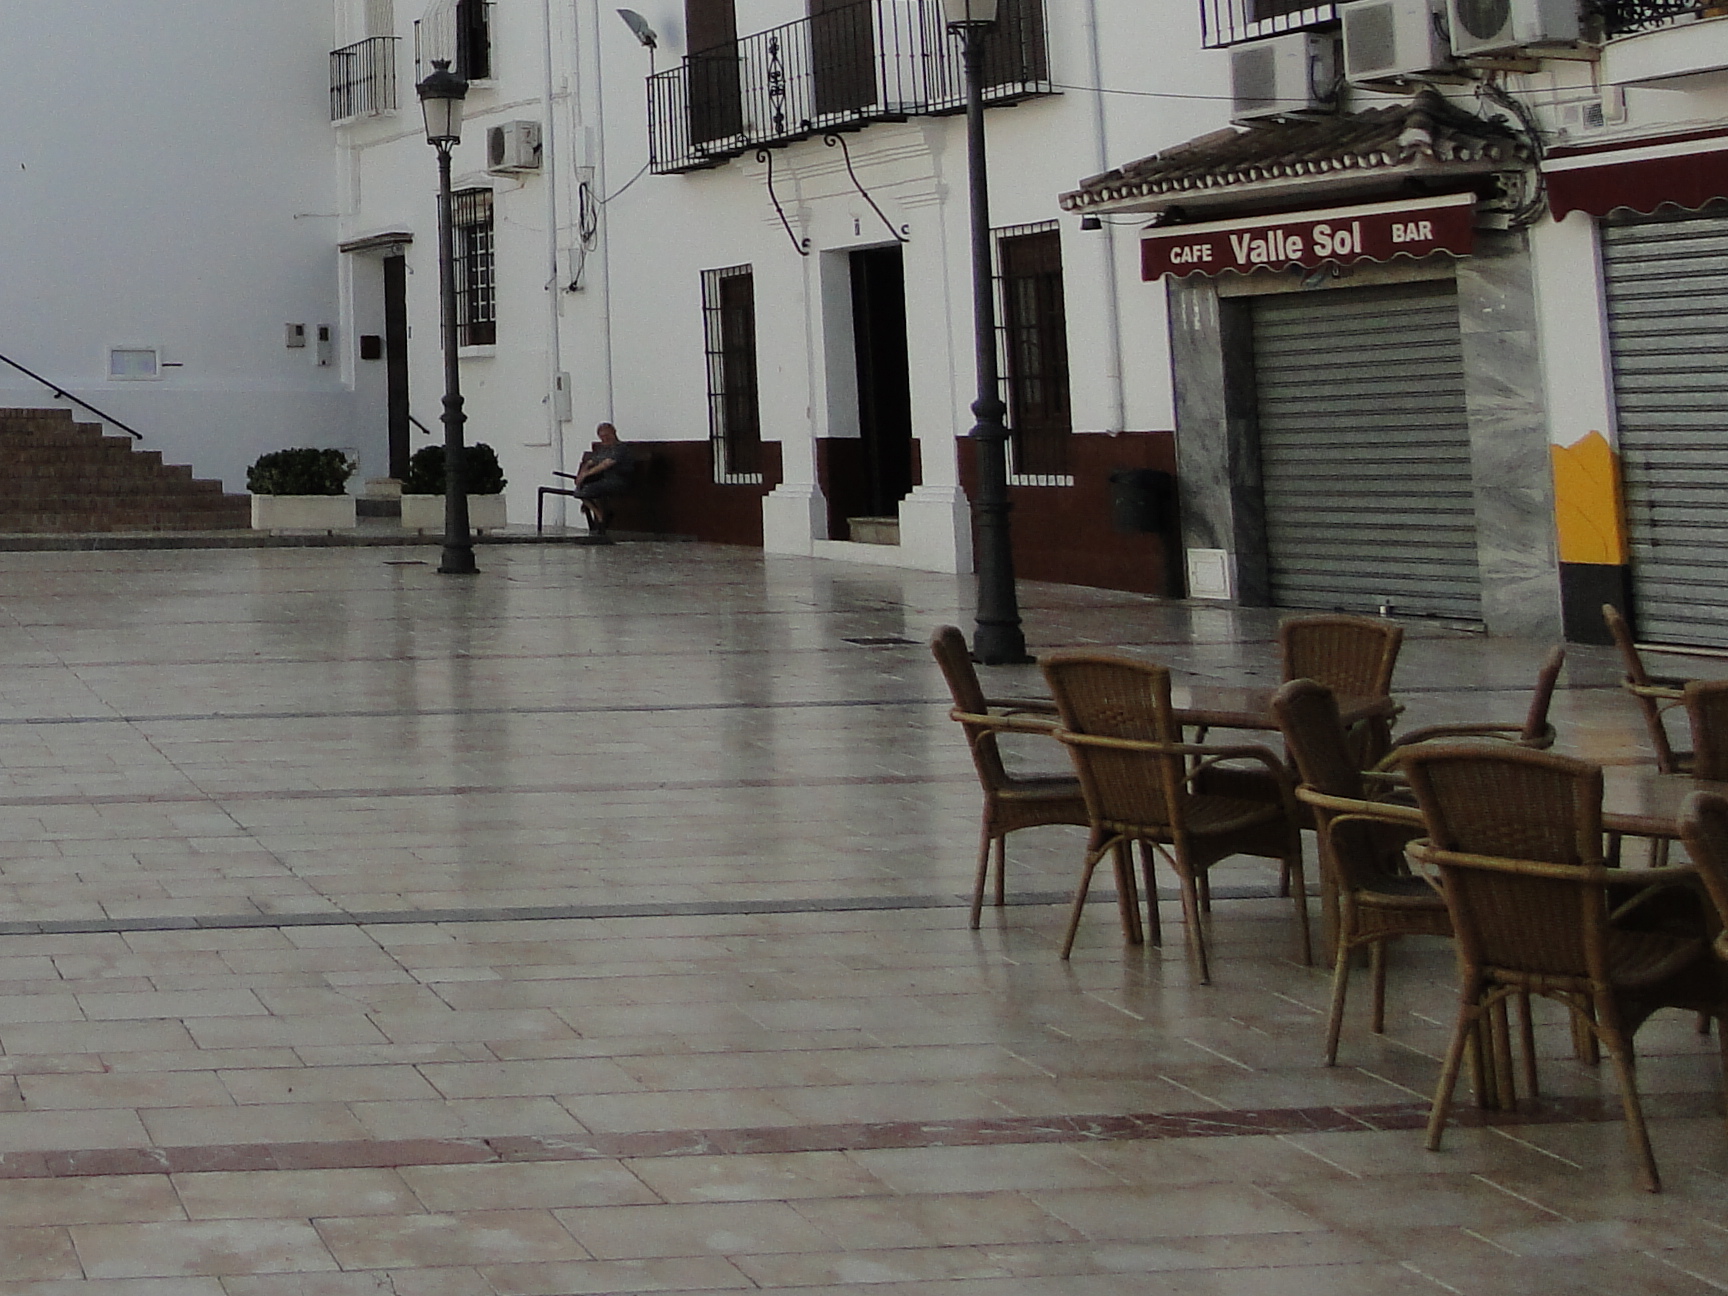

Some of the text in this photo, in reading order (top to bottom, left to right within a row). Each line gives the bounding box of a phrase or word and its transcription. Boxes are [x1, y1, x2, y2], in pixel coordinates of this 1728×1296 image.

[1170, 221, 1433, 264] CAFE Valle Sol BAR
